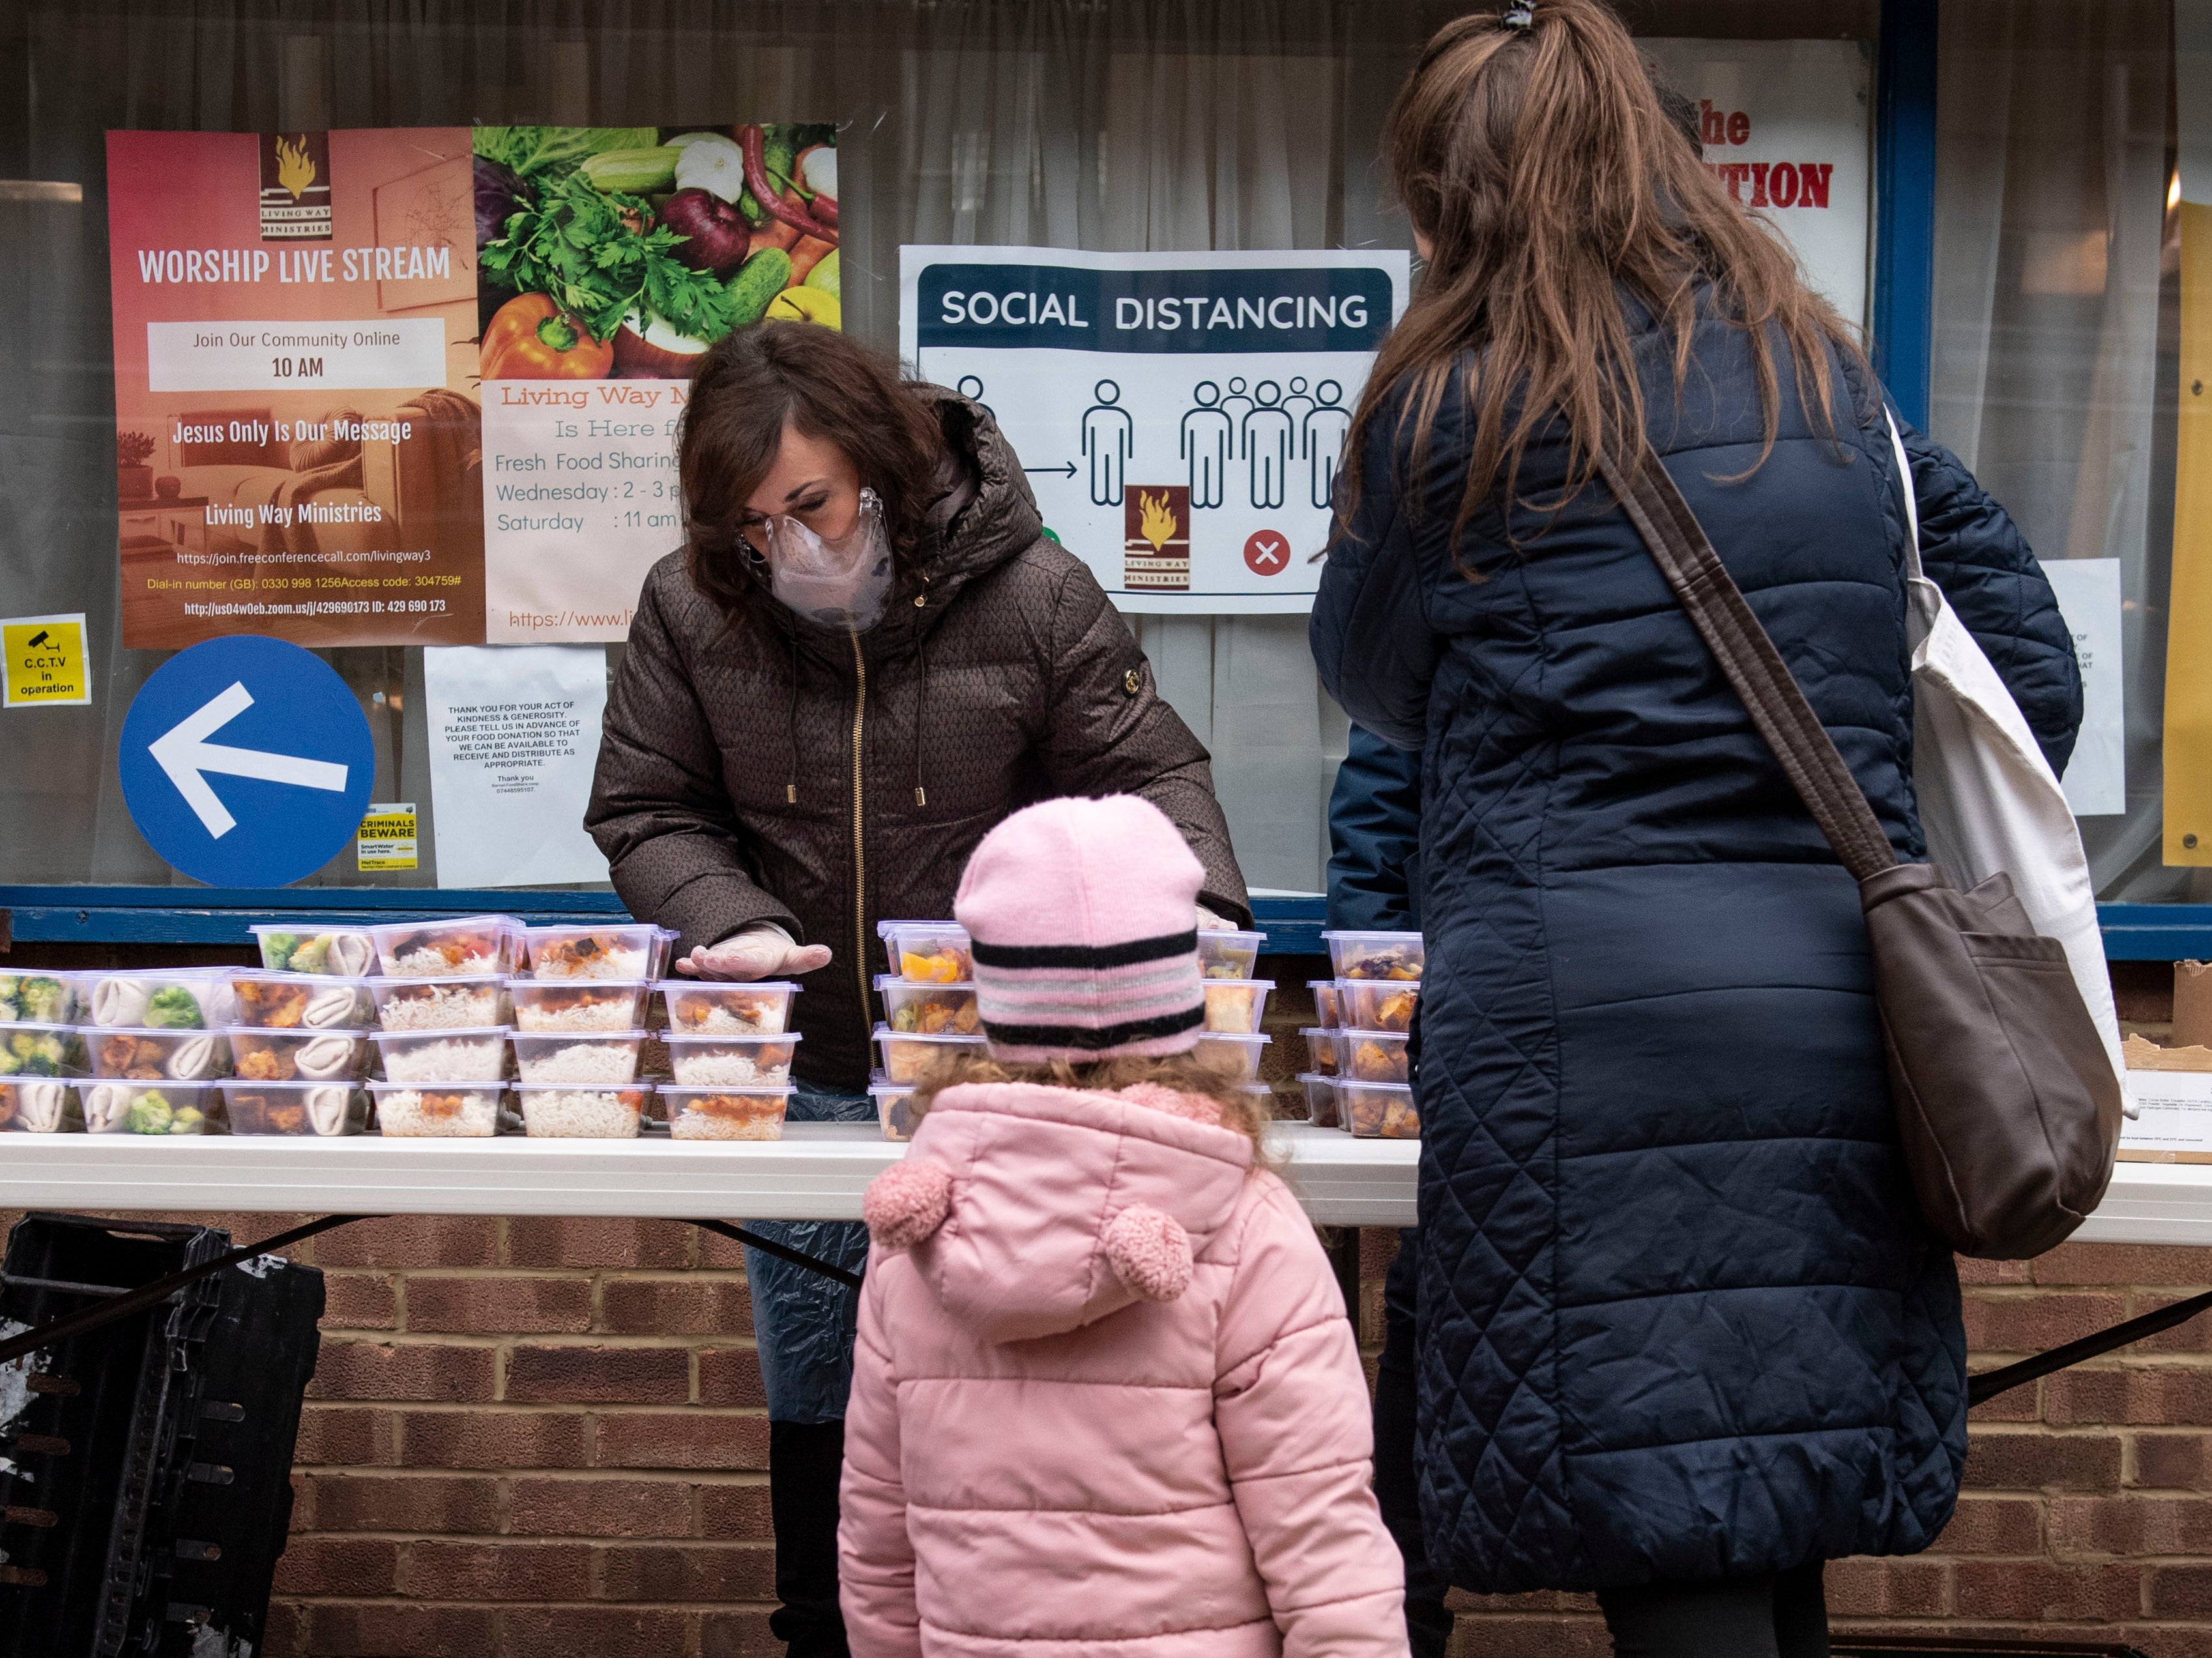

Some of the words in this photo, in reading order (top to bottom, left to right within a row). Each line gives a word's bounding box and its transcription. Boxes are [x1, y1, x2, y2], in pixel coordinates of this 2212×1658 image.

[1704, 162, 1833, 209] TION
[261, 225, 330, 233] MINISTRIES
[138, 250, 269, 283] WORSHIP
[279, 248, 334, 283] LIVE
[342, 246, 450, 281] STREAM
[942, 291, 1088, 328] SOCIAL
[1116, 295, 1368, 330] DISTANCING
[193, 333, 223, 348] Join
[229, 333, 256, 347] Our
[261, 332, 347, 350] Community
[353, 332, 400, 346] Online
[272, 358, 292, 377] 10
[298, 357, 323, 377] AM
[502, 386, 589, 409] Living
[597, 386, 661, 408] Way
[173, 422, 224, 444] Jesus
[229, 420, 269, 447] Only
[274, 421, 289, 442] Is
[295, 420, 328, 442] Our
[334, 420, 411, 444] Message
[555, 421, 578, 438] Is
[588, 420, 654, 437] Here
[496, 454, 546, 472] Fresh
[557, 453, 602, 470] Food
[609, 452, 680, 472] Sharing
[624, 482, 633, 498] 2
[653, 481, 663, 497] 3
[205, 504, 254, 529] Living
[259, 504, 293, 528] Way
[298, 502, 382, 524] Ministries
[498, 513, 583, 532] Saturday
[624, 512, 640, 527] 11
[647, 514, 676, 527] am
[177, 550, 431, 566] https://join.freeconferencecall.com/livingway3
[147, 579, 181, 589] Dial-in
[185, 579, 226, 589] number
[230, 579, 258, 591] (GB):
[261, 578, 288, 589] 0330
[291, 578, 312, 588] 998
[383, 577, 411, 587] code:
[415, 575, 461, 586] 304759#
[372, 601, 385, 613] ID:
[387, 601, 405, 612] 429
[408, 600, 427, 612] 690
[429, 600, 445, 611] 173
[24, 657, 66, 669] C.C.T.V
[42, 671, 52, 681] in
[21, 683, 74, 696] operation
[458, 714, 501, 723] KINDNESS
[511, 711, 567, 720] GENEROSITY.
[498, 731, 542, 740] DONATION
[508, 740, 555, 749] AVAILABLE
[454, 752, 490, 761] RECEIVE
[512, 749, 561, 758] DISTRIBUTE
[484, 759, 546, 768] APPROPRIATE.
[360, 828, 415, 838] BEWARE
